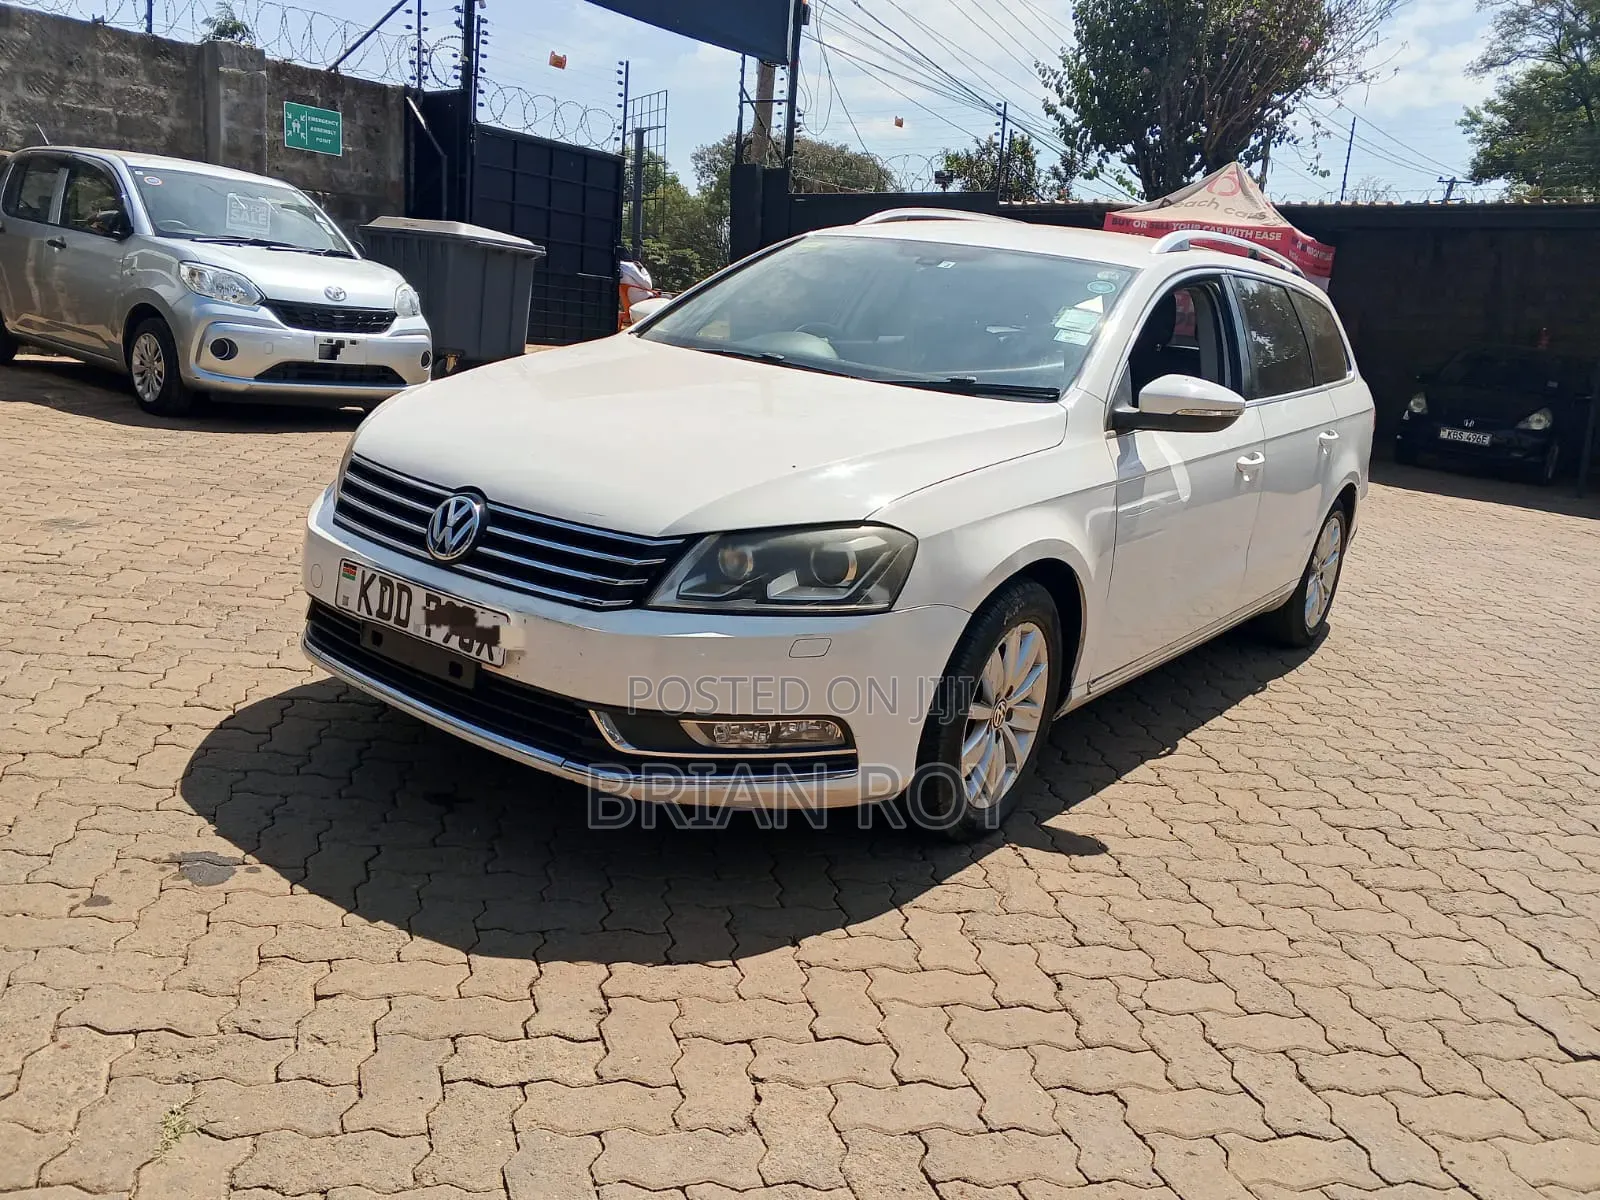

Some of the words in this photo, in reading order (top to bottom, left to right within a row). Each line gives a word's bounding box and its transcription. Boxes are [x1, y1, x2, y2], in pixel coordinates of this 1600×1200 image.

[307, 115, 339, 127] EMERGENCY
[310, 126, 337, 136] ASSEMBLY
[315, 137, 332, 145] POINT
[230, 209, 267, 225] SALE
[1111, 216, 1131, 226] BUY
[1132, 219, 1148, 229] OR
[1225, 226, 1253, 239] WITH
[1255, 230, 1282, 241] EASE
[1447, 430, 1463, 440] KBS
[1466, 432, 1488, 444] 496E
[357, 570, 412, 628] KDD
